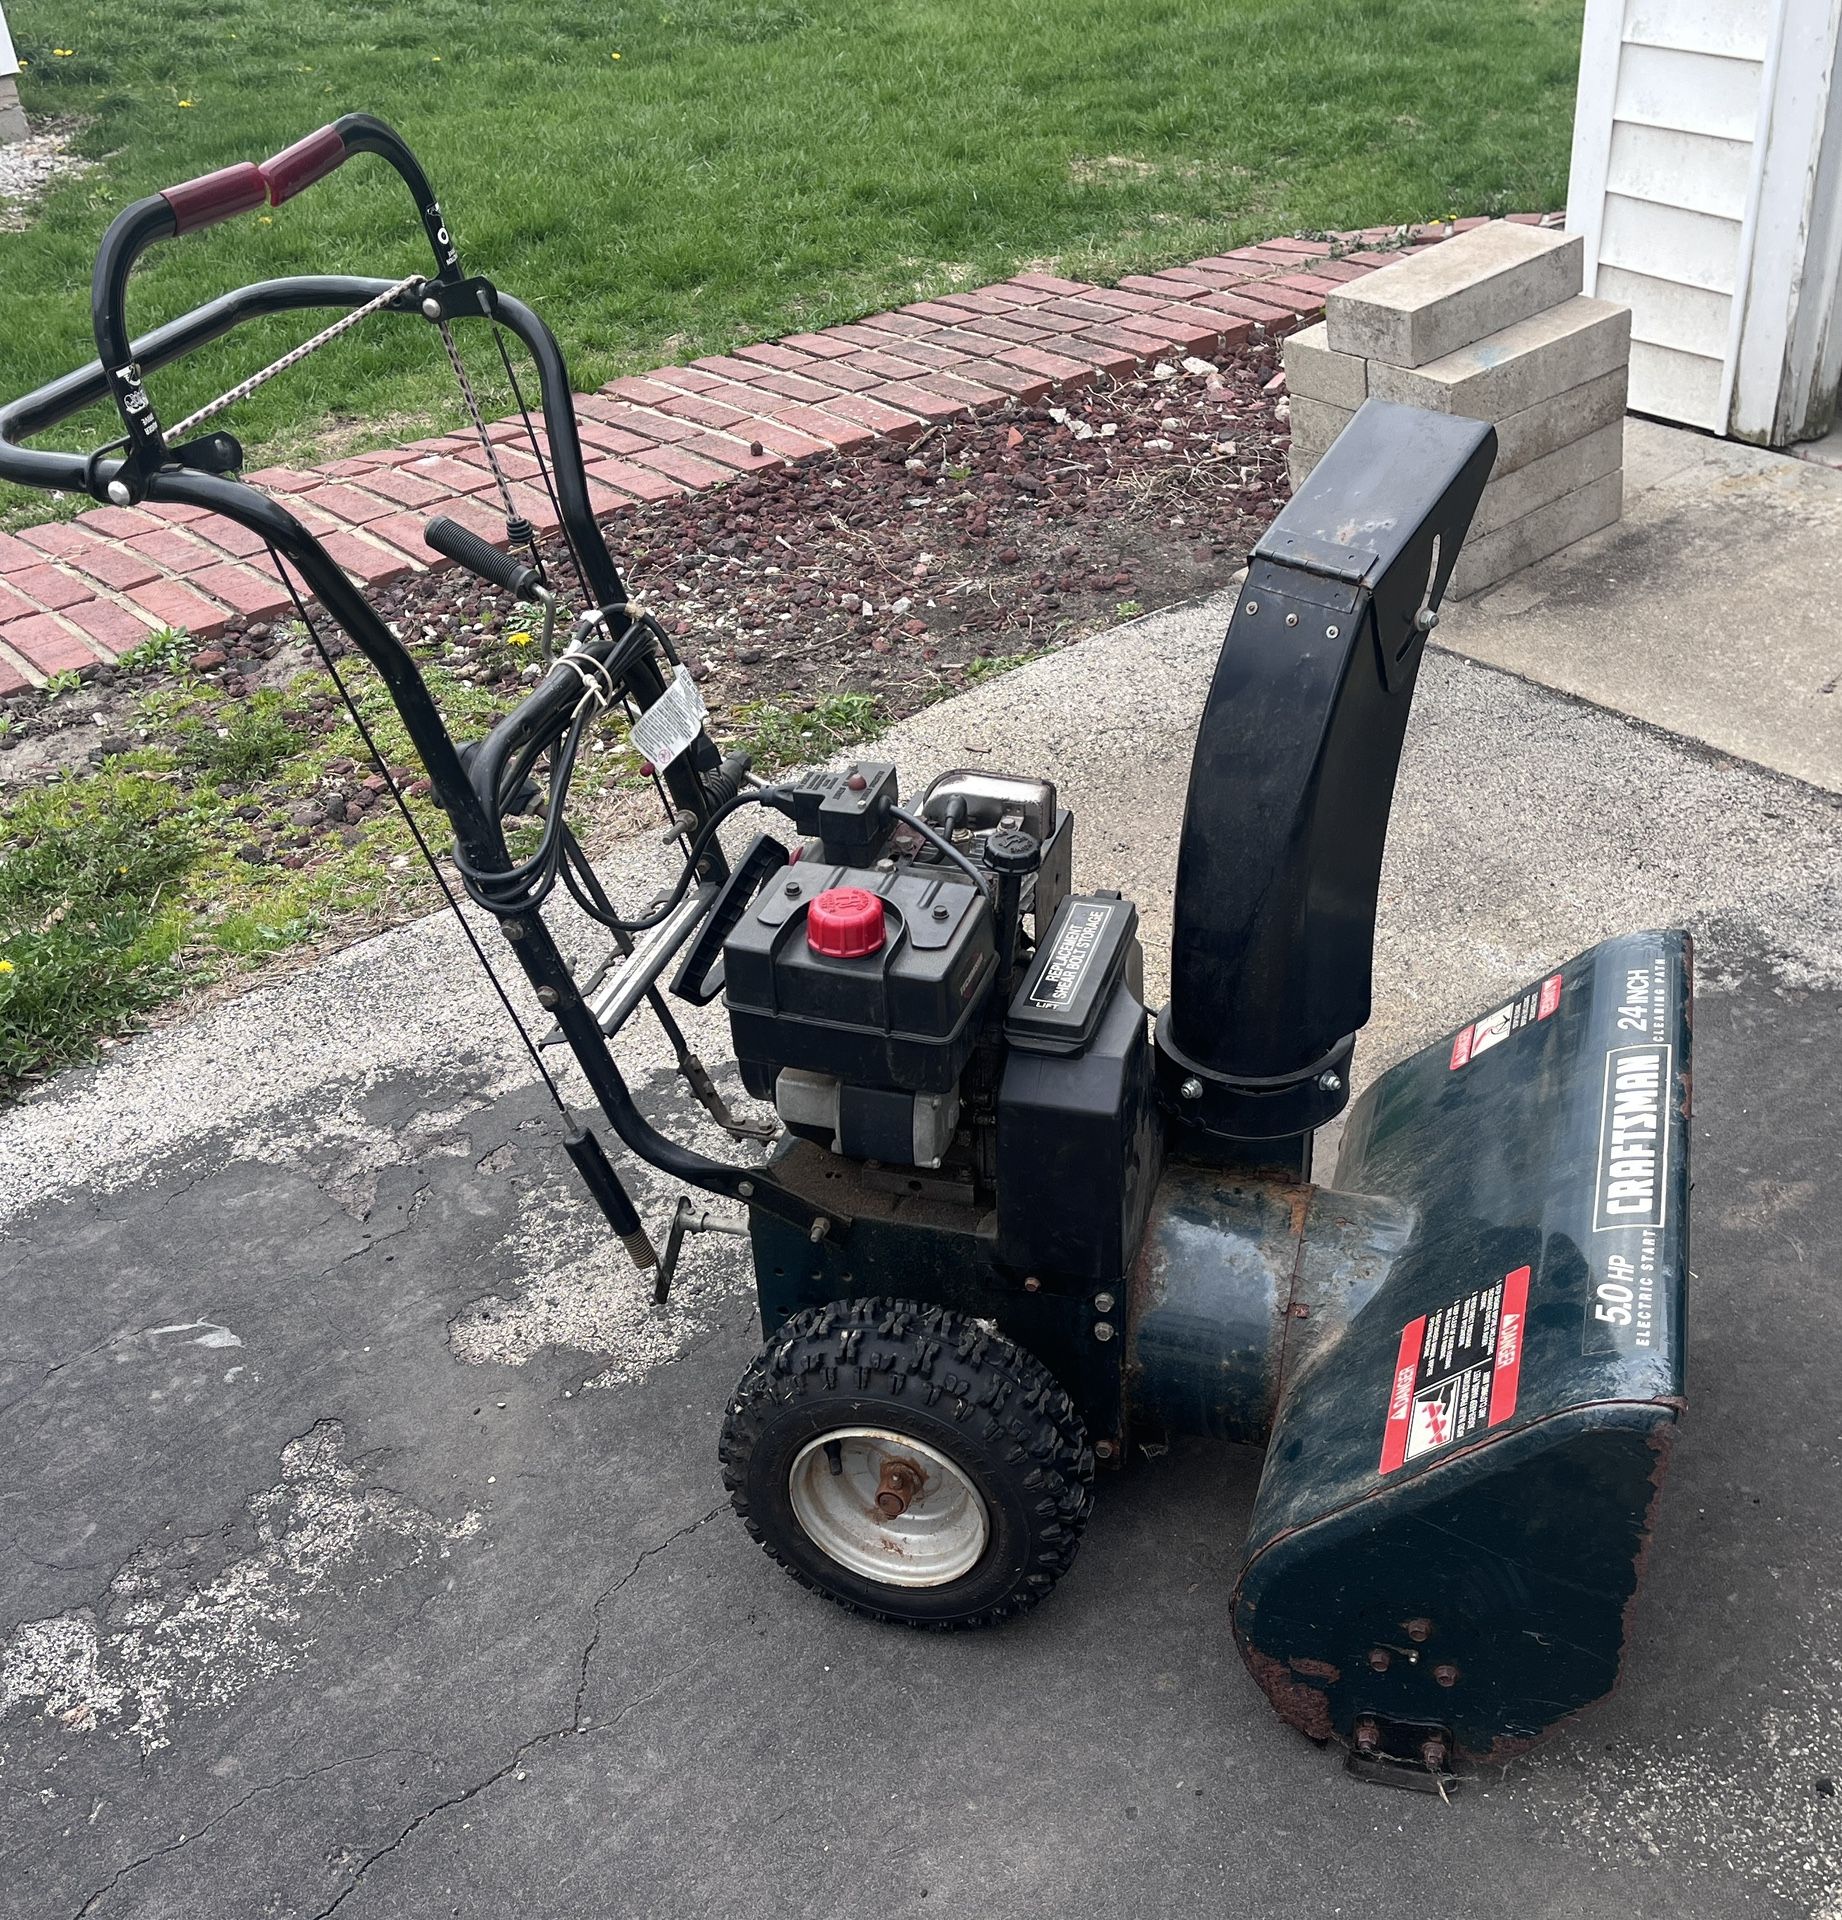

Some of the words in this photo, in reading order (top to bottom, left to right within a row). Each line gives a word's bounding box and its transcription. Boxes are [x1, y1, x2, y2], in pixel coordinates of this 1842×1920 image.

[1076, 911, 1104, 949] STORAGE
[1044, 924, 1083, 982] REPLACEMENT
[1066, 948, 1087, 971] BOLT
[1654, 959, 1666, 983] PATH
[1052, 970, 1077, 999] SHEAR
[1626, 969, 1650, 1004] INCH
[1036, 1001, 1060, 1010] LIFT
[1617, 1005, 1648, 1032] 24
[1652, 988, 1666, 1042] CLEARING
[1606, 1054, 1660, 1215] CRAFTSMAN
[1607, 1254, 1635, 1282] HP
[1640, 1229, 1656, 1271] START
[1595, 1283, 1634, 1326] 5.0
[1635, 1277, 1653, 1347] ELECTRIC
[1496, 1322, 1518, 1370] DANGER
[1393, 1363, 1414, 1409] DANGER
